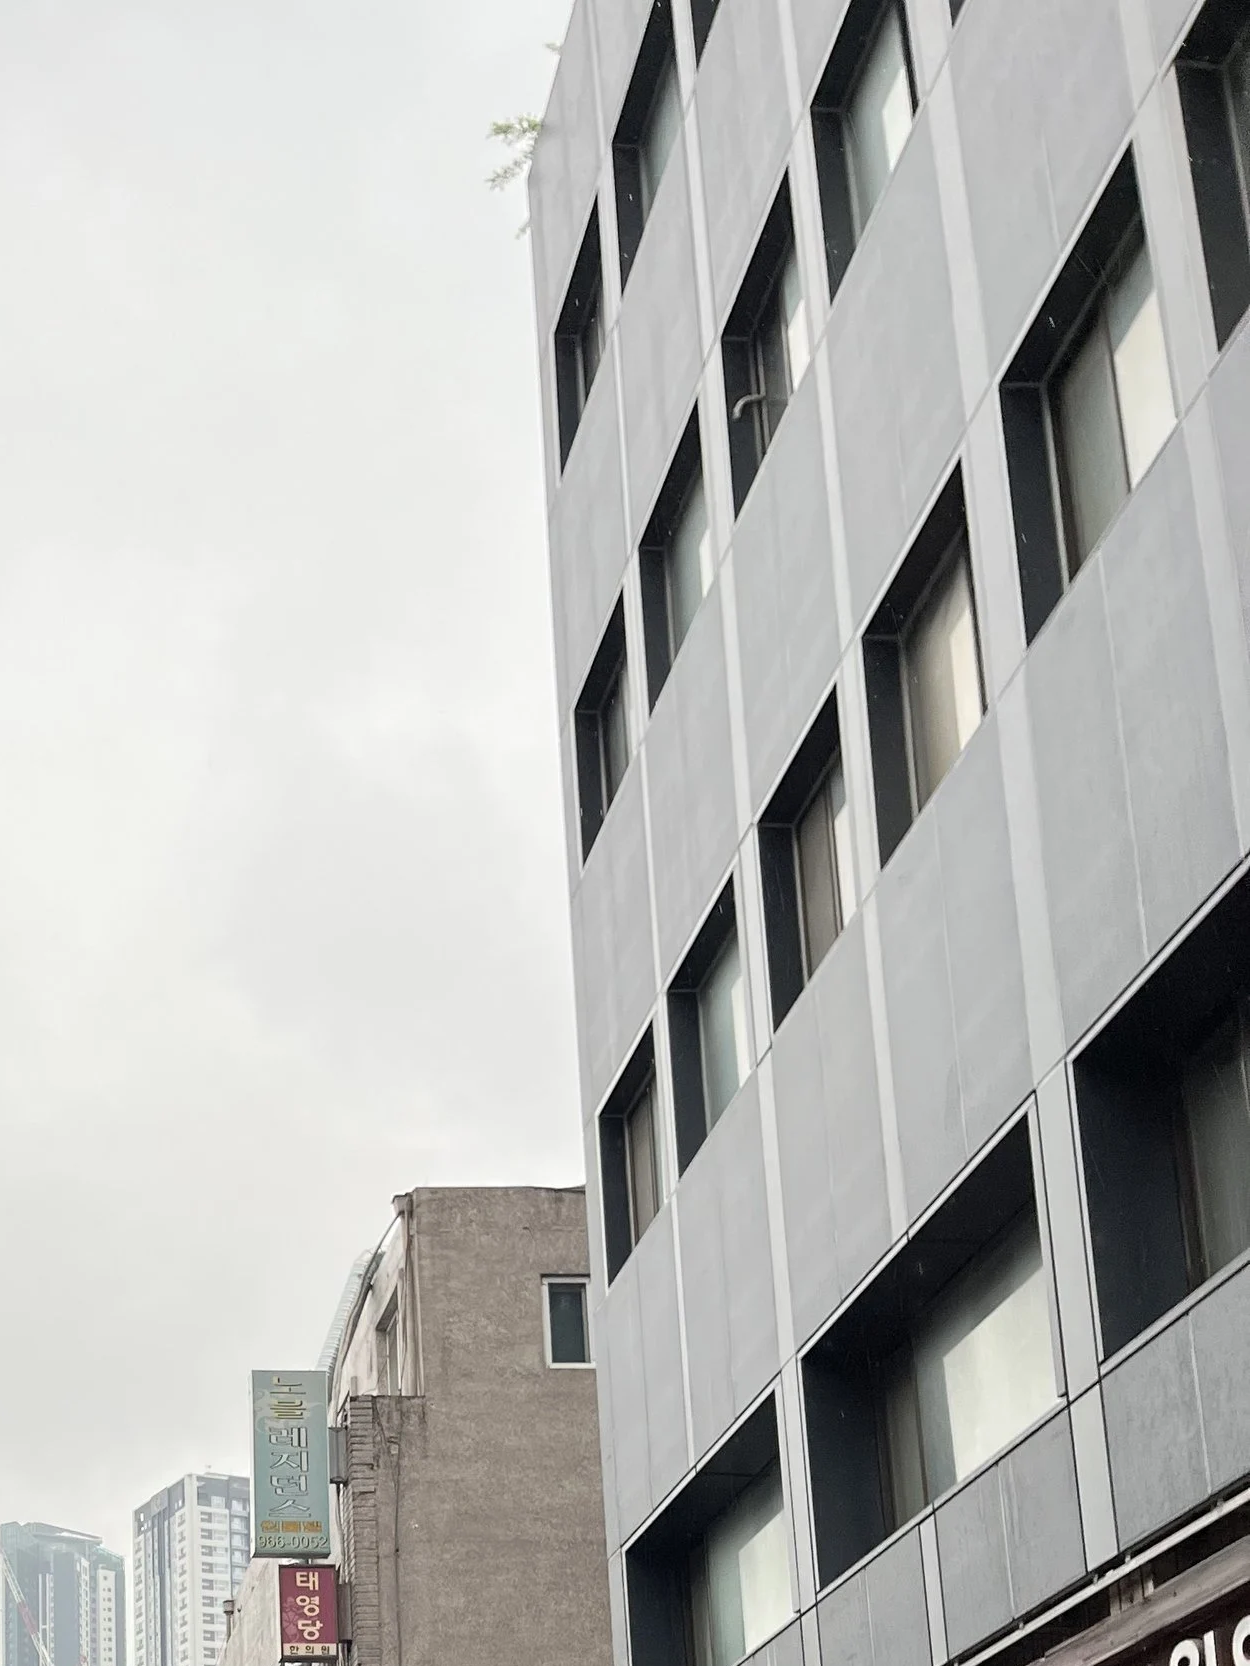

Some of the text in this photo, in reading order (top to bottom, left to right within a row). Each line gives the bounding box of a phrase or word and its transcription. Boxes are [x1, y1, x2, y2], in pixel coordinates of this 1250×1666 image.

[268, 1375, 312, 1518] 노블레지던스
[295, 1571, 324, 1641] 태영당
[289, 1645, 330, 1655] 한의원
